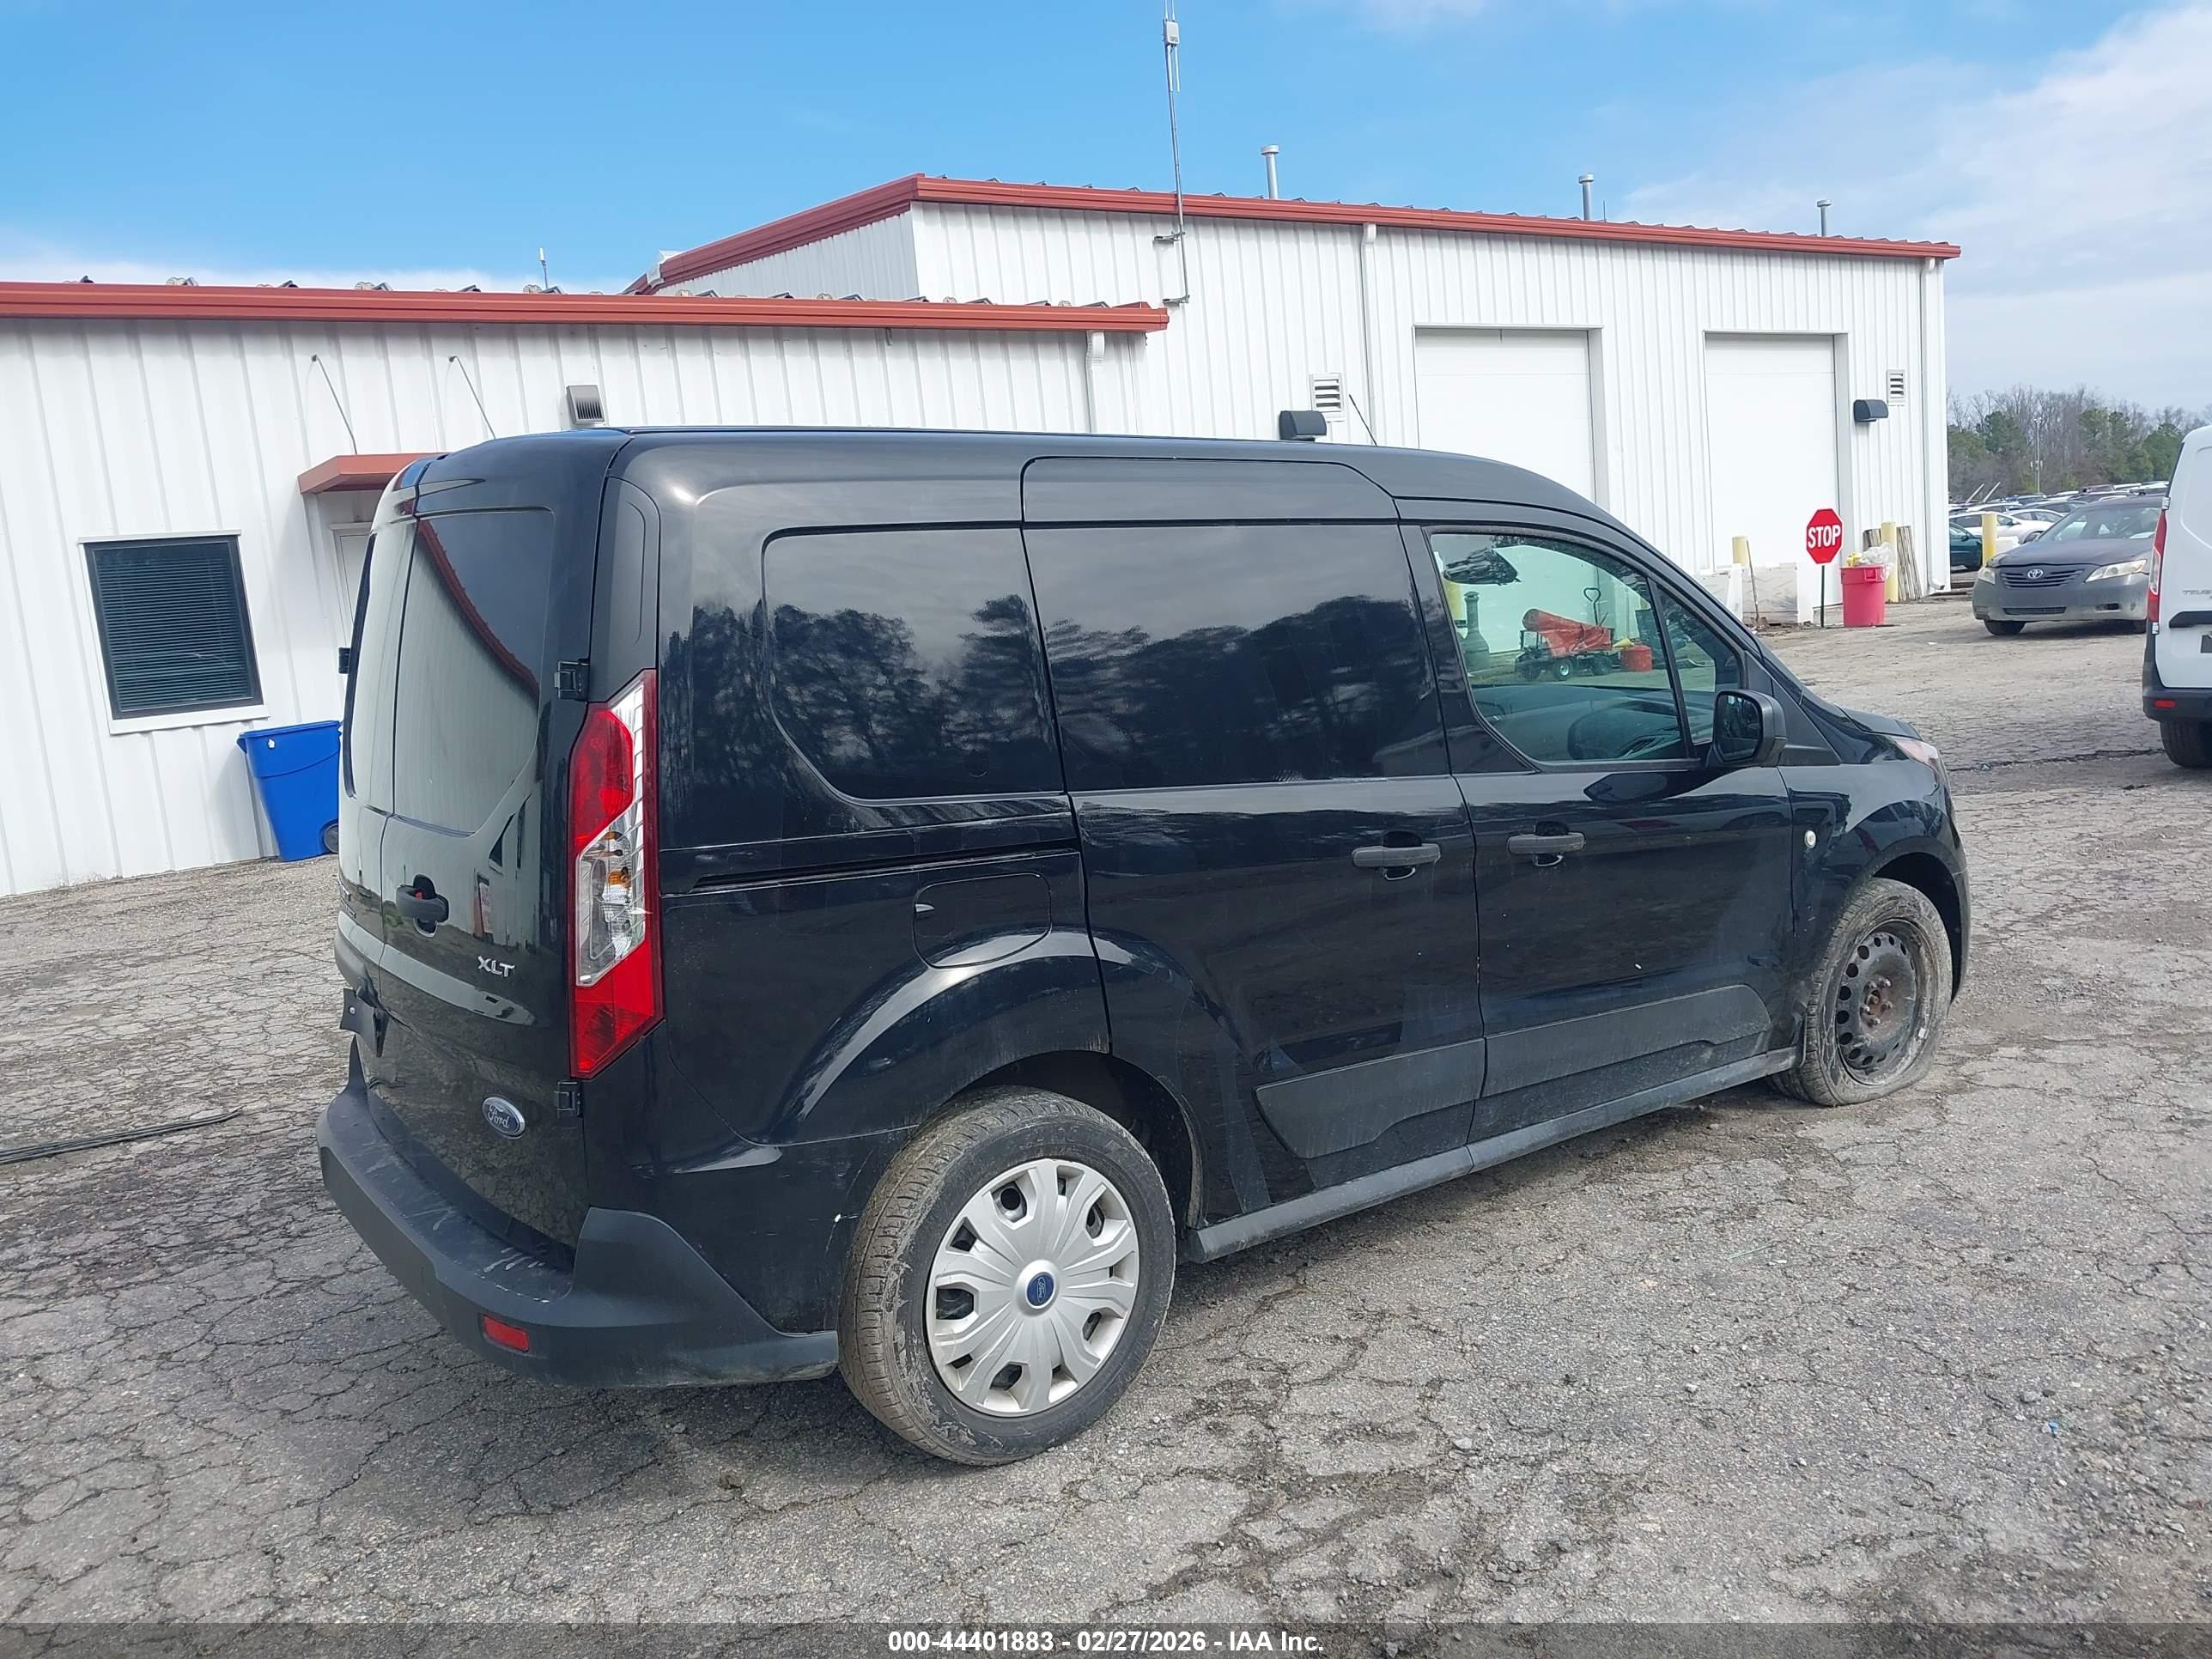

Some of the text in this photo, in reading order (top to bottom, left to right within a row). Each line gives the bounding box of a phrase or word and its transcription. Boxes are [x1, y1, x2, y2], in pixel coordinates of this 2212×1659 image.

[1808, 524, 1841, 549] STOP
[477, 956, 515, 977] XLT
[488, 1104, 510, 1129] Ford
